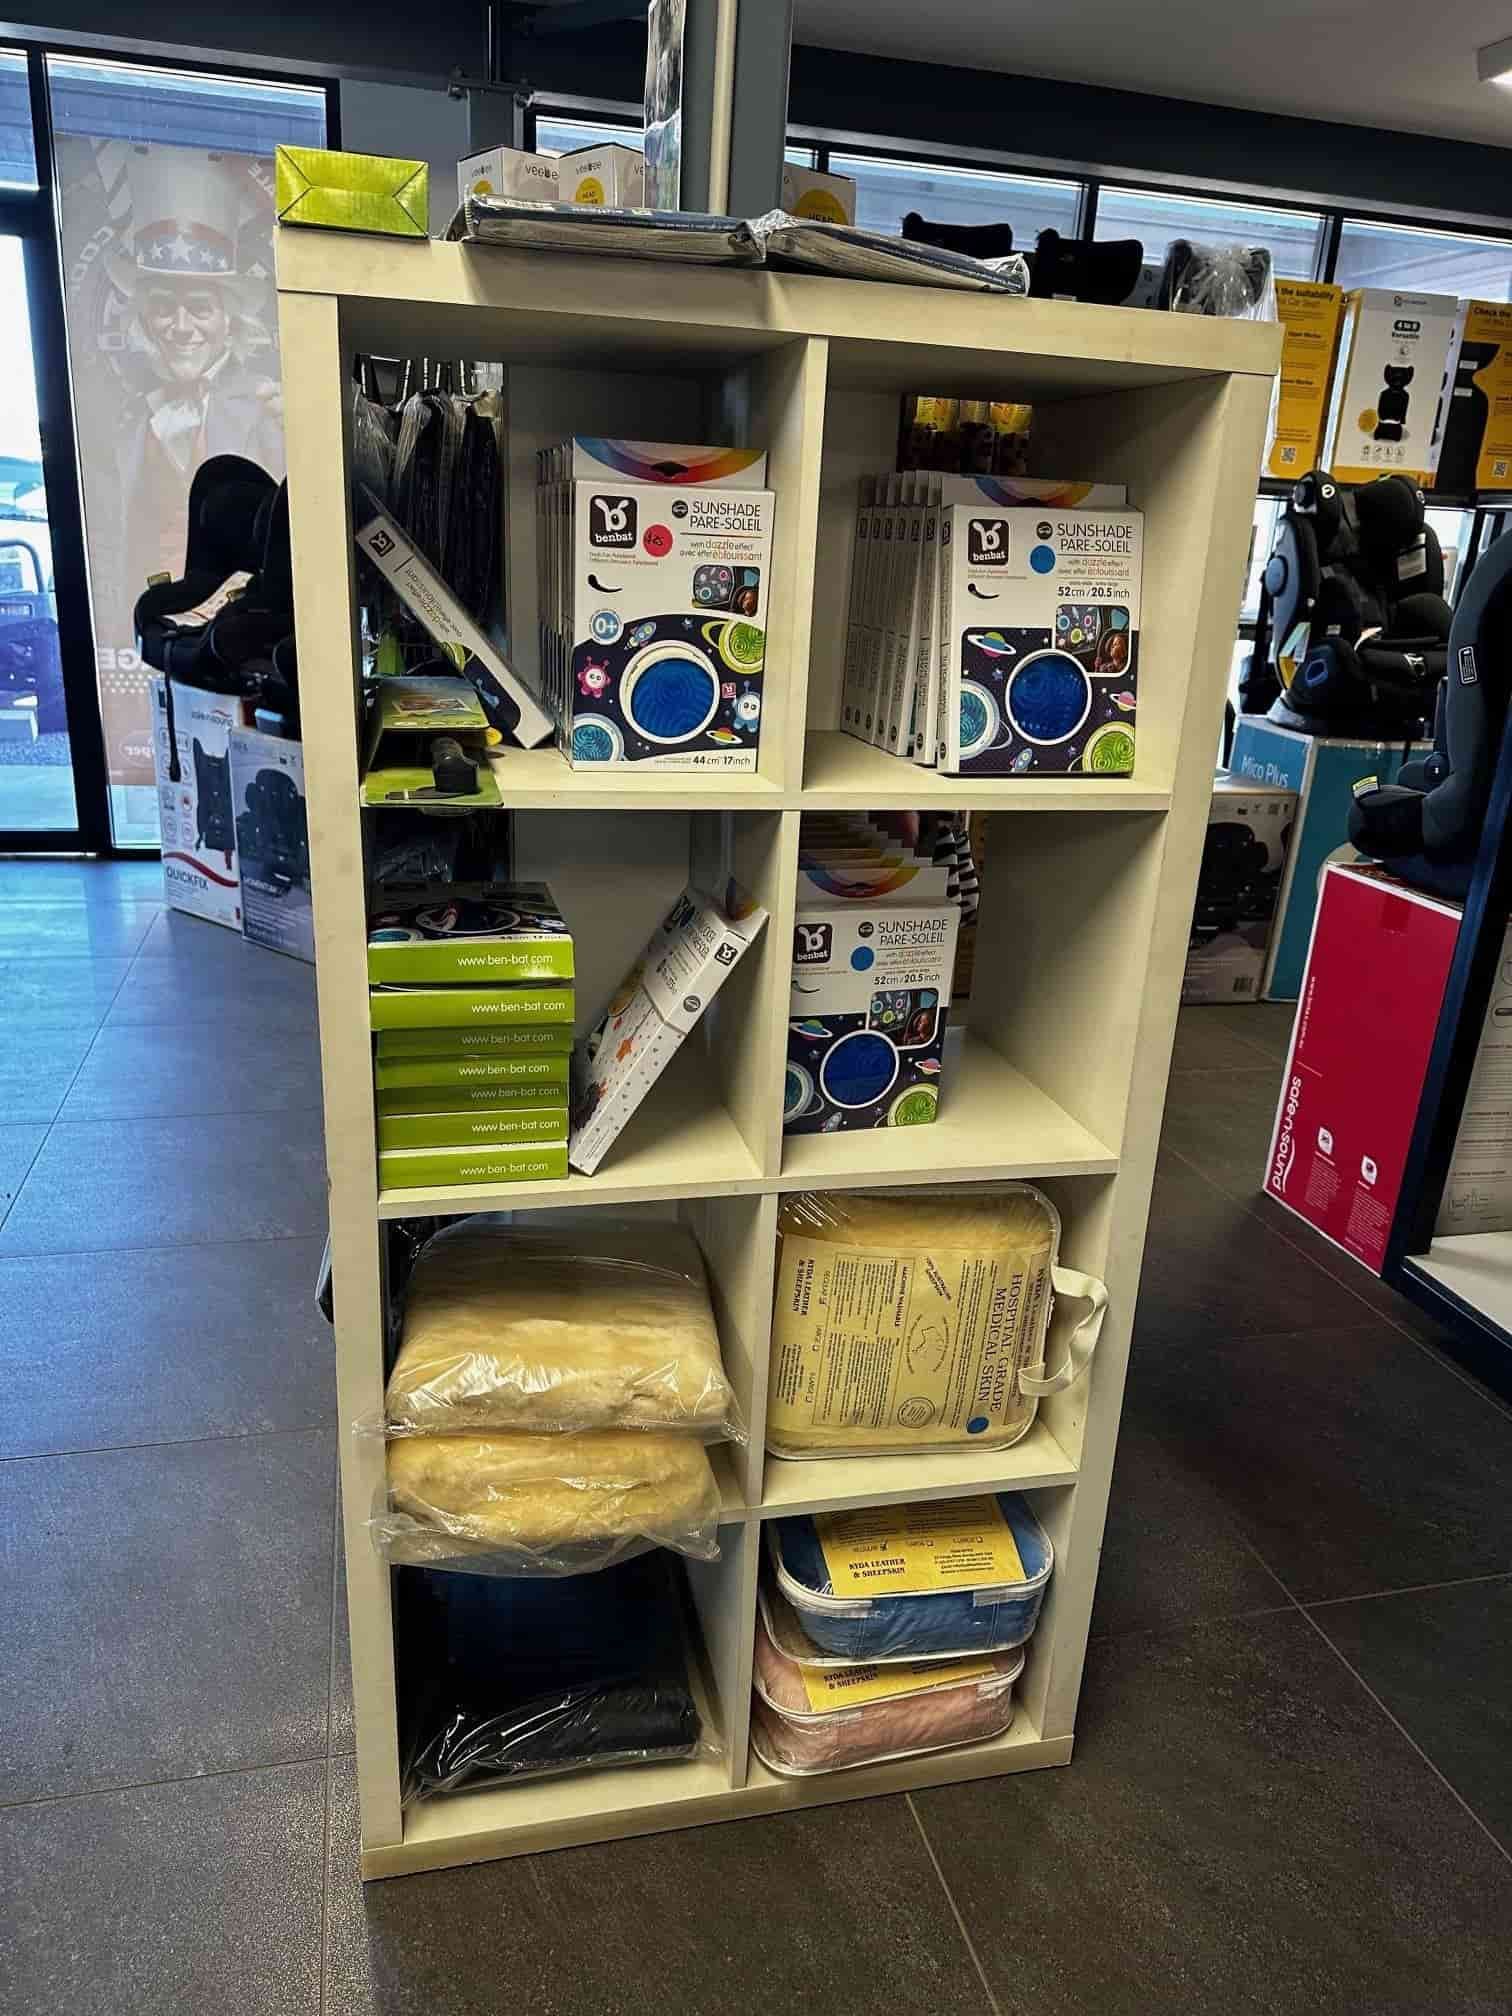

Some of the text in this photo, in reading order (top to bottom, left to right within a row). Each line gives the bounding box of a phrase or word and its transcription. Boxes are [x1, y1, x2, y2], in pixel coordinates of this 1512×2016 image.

[692, 501, 761, 518] SUNSHADE
[690, 515, 763, 532] PARE-SOLEIL
[594, 531, 634, 544] benbat
[1057, 523, 1133, 539] SUNSHADE
[1060, 539, 1132, 553] PARE-SOLEIL
[972, 551, 1007, 562] benbat
[599, 617, 618, 634] 0+
[1241, 754, 1289, 789] Mico Plus
[878, 918, 949, 934] SUNSHADE
[880, 932, 945, 946] PARE-SOLEIL
[456, 953, 553, 967] www.ben-bat.com
[797, 950, 829, 962] benbat
[471, 1001, 566, 1014] www.ben-bat.com
[458, 1063, 550, 1076] www.ben-bat.com
[471, 1119, 561, 1132] www.ben-bat.com
[460, 1162, 549, 1176] www.ben-bat.com
[792, 1267, 804, 1313] SHEEPSKIN
[800, 1280, 813, 1317] LEATHER
[1000, 1272, 1024, 1353] HOSPITAL
[978, 1287, 1008, 1401] MEDICAL SKIN
[990, 1357, 1009, 1413] GRADE
[870, 1557, 906, 1568] LEATHER
[853, 1566, 906, 1579] & SHEEPSKIN
